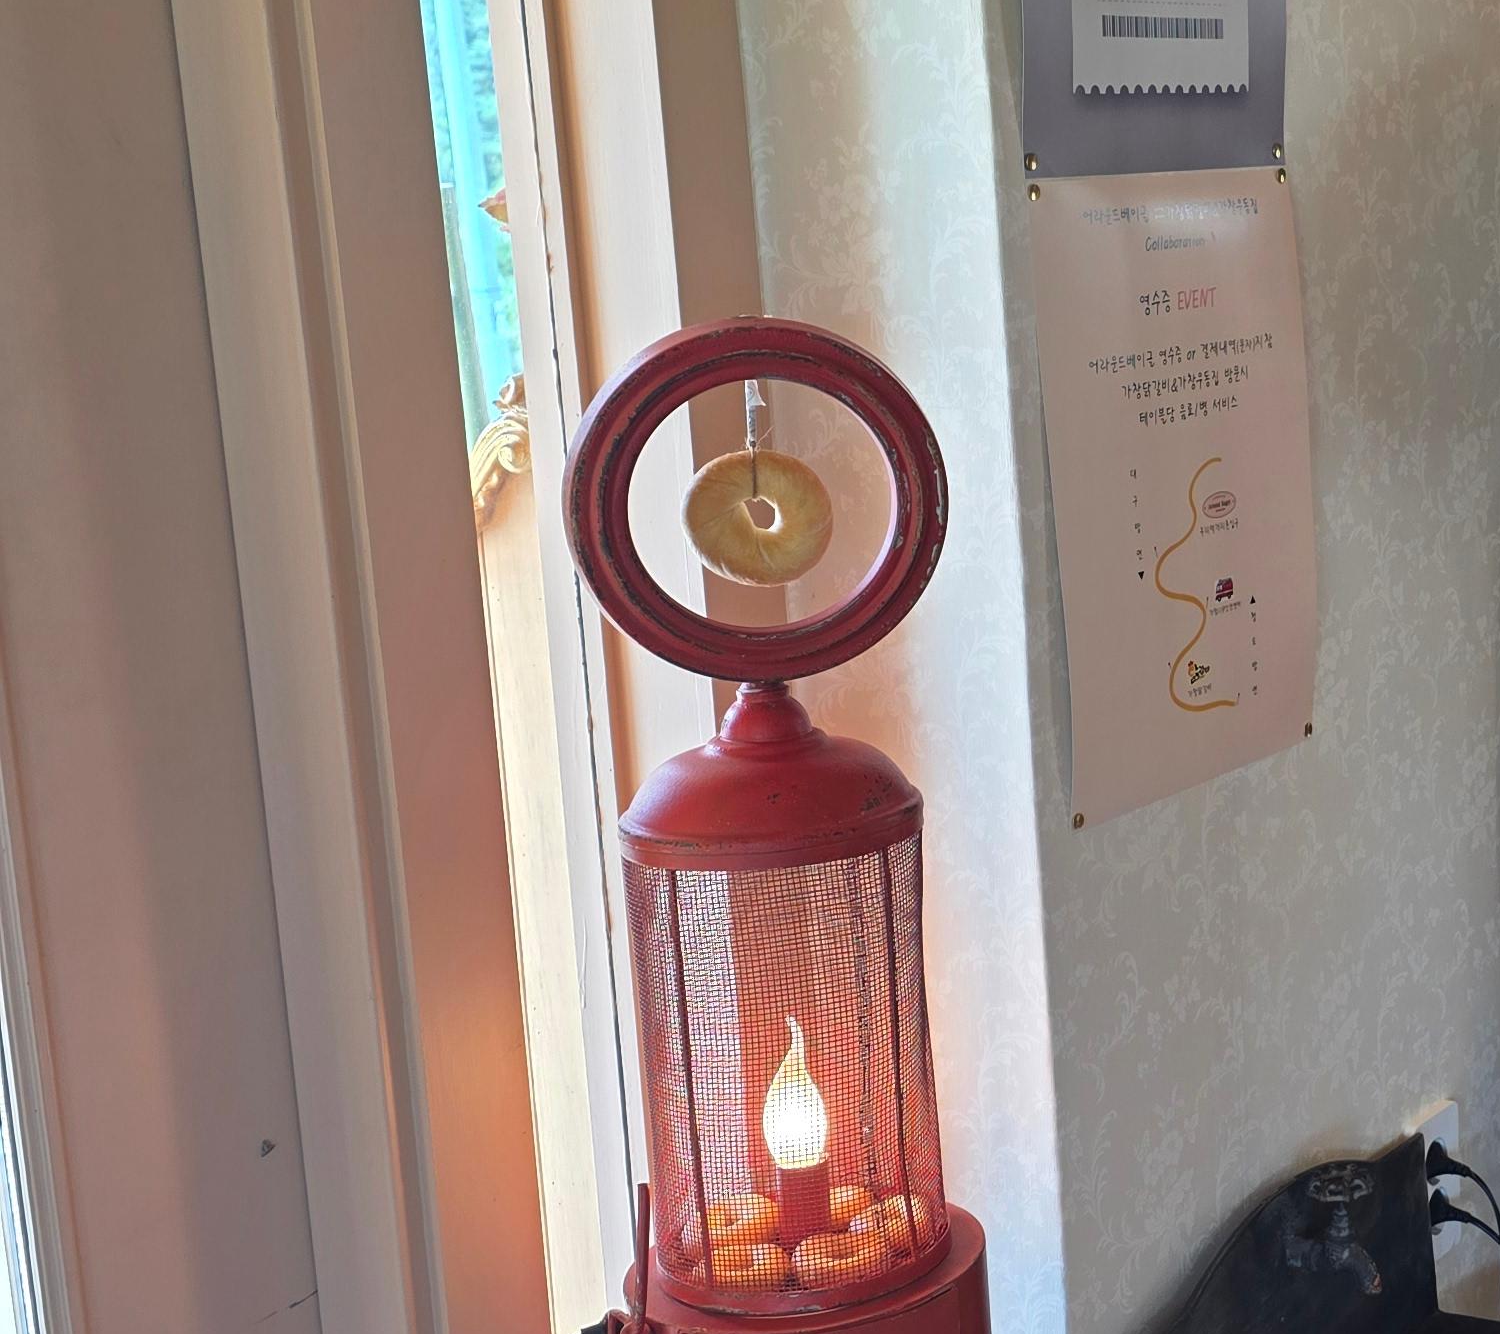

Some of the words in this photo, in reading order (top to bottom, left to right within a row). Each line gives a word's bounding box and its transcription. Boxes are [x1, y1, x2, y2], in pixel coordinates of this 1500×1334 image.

[1139, 289, 1172, 317] 영수증
[1177, 286, 1218, 311] EVENT
[1088, 350, 1156, 375] 어라운드베이글
[1158, 346, 1183, 367] 영수증
[1186, 350, 1197, 362] or
[1224, 365, 1249, 383] 방문시
[1138, 406, 1175, 428] 테이블당
[1212, 394, 1239, 412] 서비스
